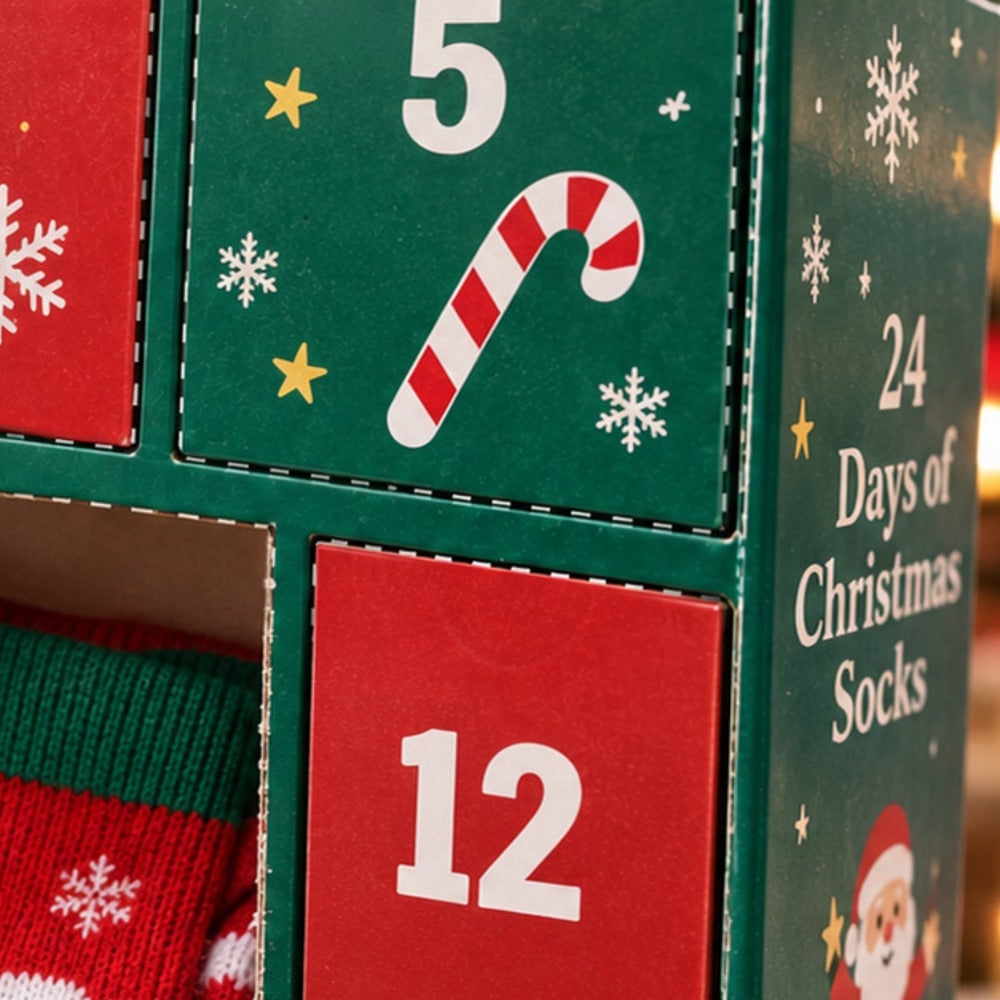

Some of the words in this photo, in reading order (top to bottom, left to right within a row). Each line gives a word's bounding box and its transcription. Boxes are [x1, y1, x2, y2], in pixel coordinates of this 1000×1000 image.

[401, 0, 507, 155] 5
[879, 313, 927, 411] 24
[835, 447, 918, 542] Days
[923, 426, 958, 507] of
[795, 551, 962, 647] Christmas
[832, 641, 928, 743] Socks
[396, 728, 583, 922] 12
